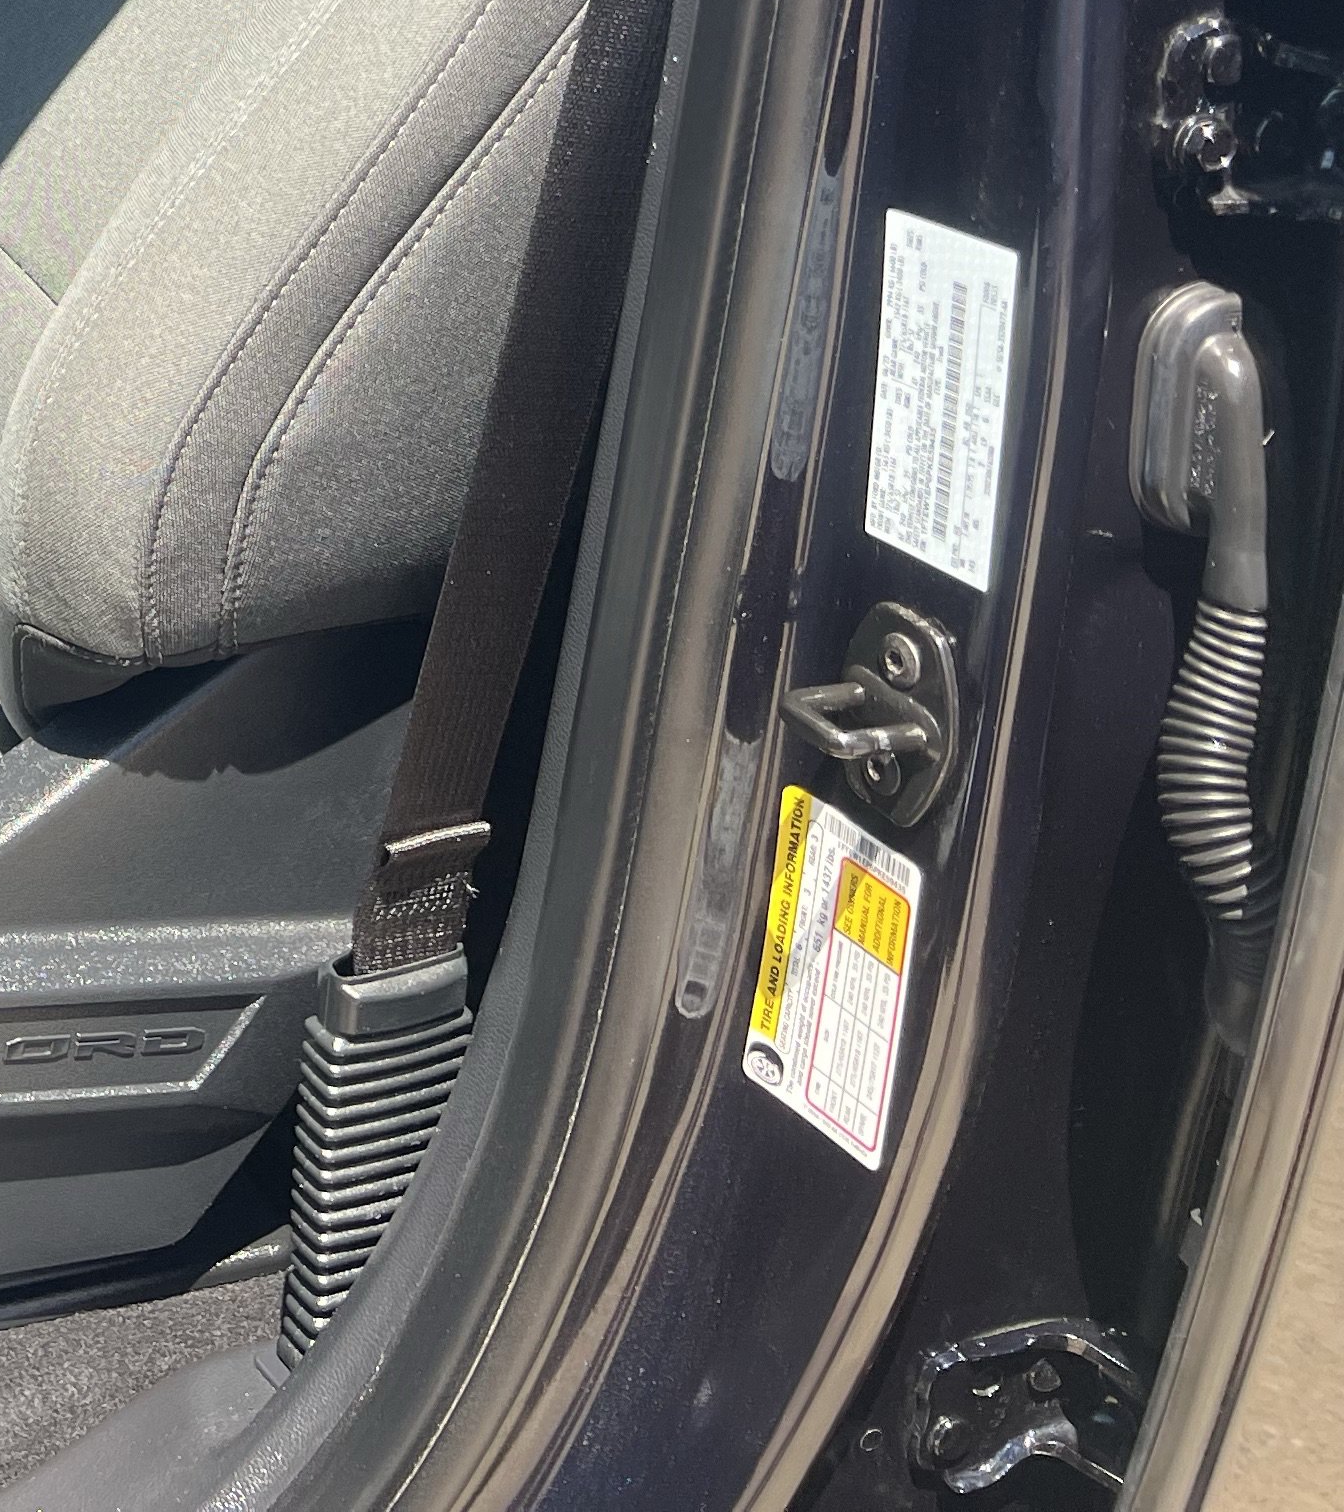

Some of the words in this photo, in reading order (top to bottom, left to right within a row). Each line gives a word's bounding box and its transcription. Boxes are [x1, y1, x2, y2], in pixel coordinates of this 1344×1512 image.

[784, 798, 805, 895] INFORMATION
[810, 834, 819, 843] 3
[803, 887, 812, 897] 3
[821, 865, 832, 896] 1437
[863, 882, 873, 904] FOR
[816, 912, 829, 928] kg
[821, 897, 829, 912] or
[772, 900, 790, 964] LOADING
[843, 915, 853, 935] SEE
[858, 906, 870, 945] MANUAL
[872, 897, 887, 952] ADDITIONAL
[886, 899, 901, 966] INFORMATION
[767, 965, 780, 997] AND
[760, 995, 774, 1030] TIRE
[783, 986, 793, 1021] CAPACITY
[779, 1022, 789, 1050] SEATING
[785, 1079, 794, 1094] The
